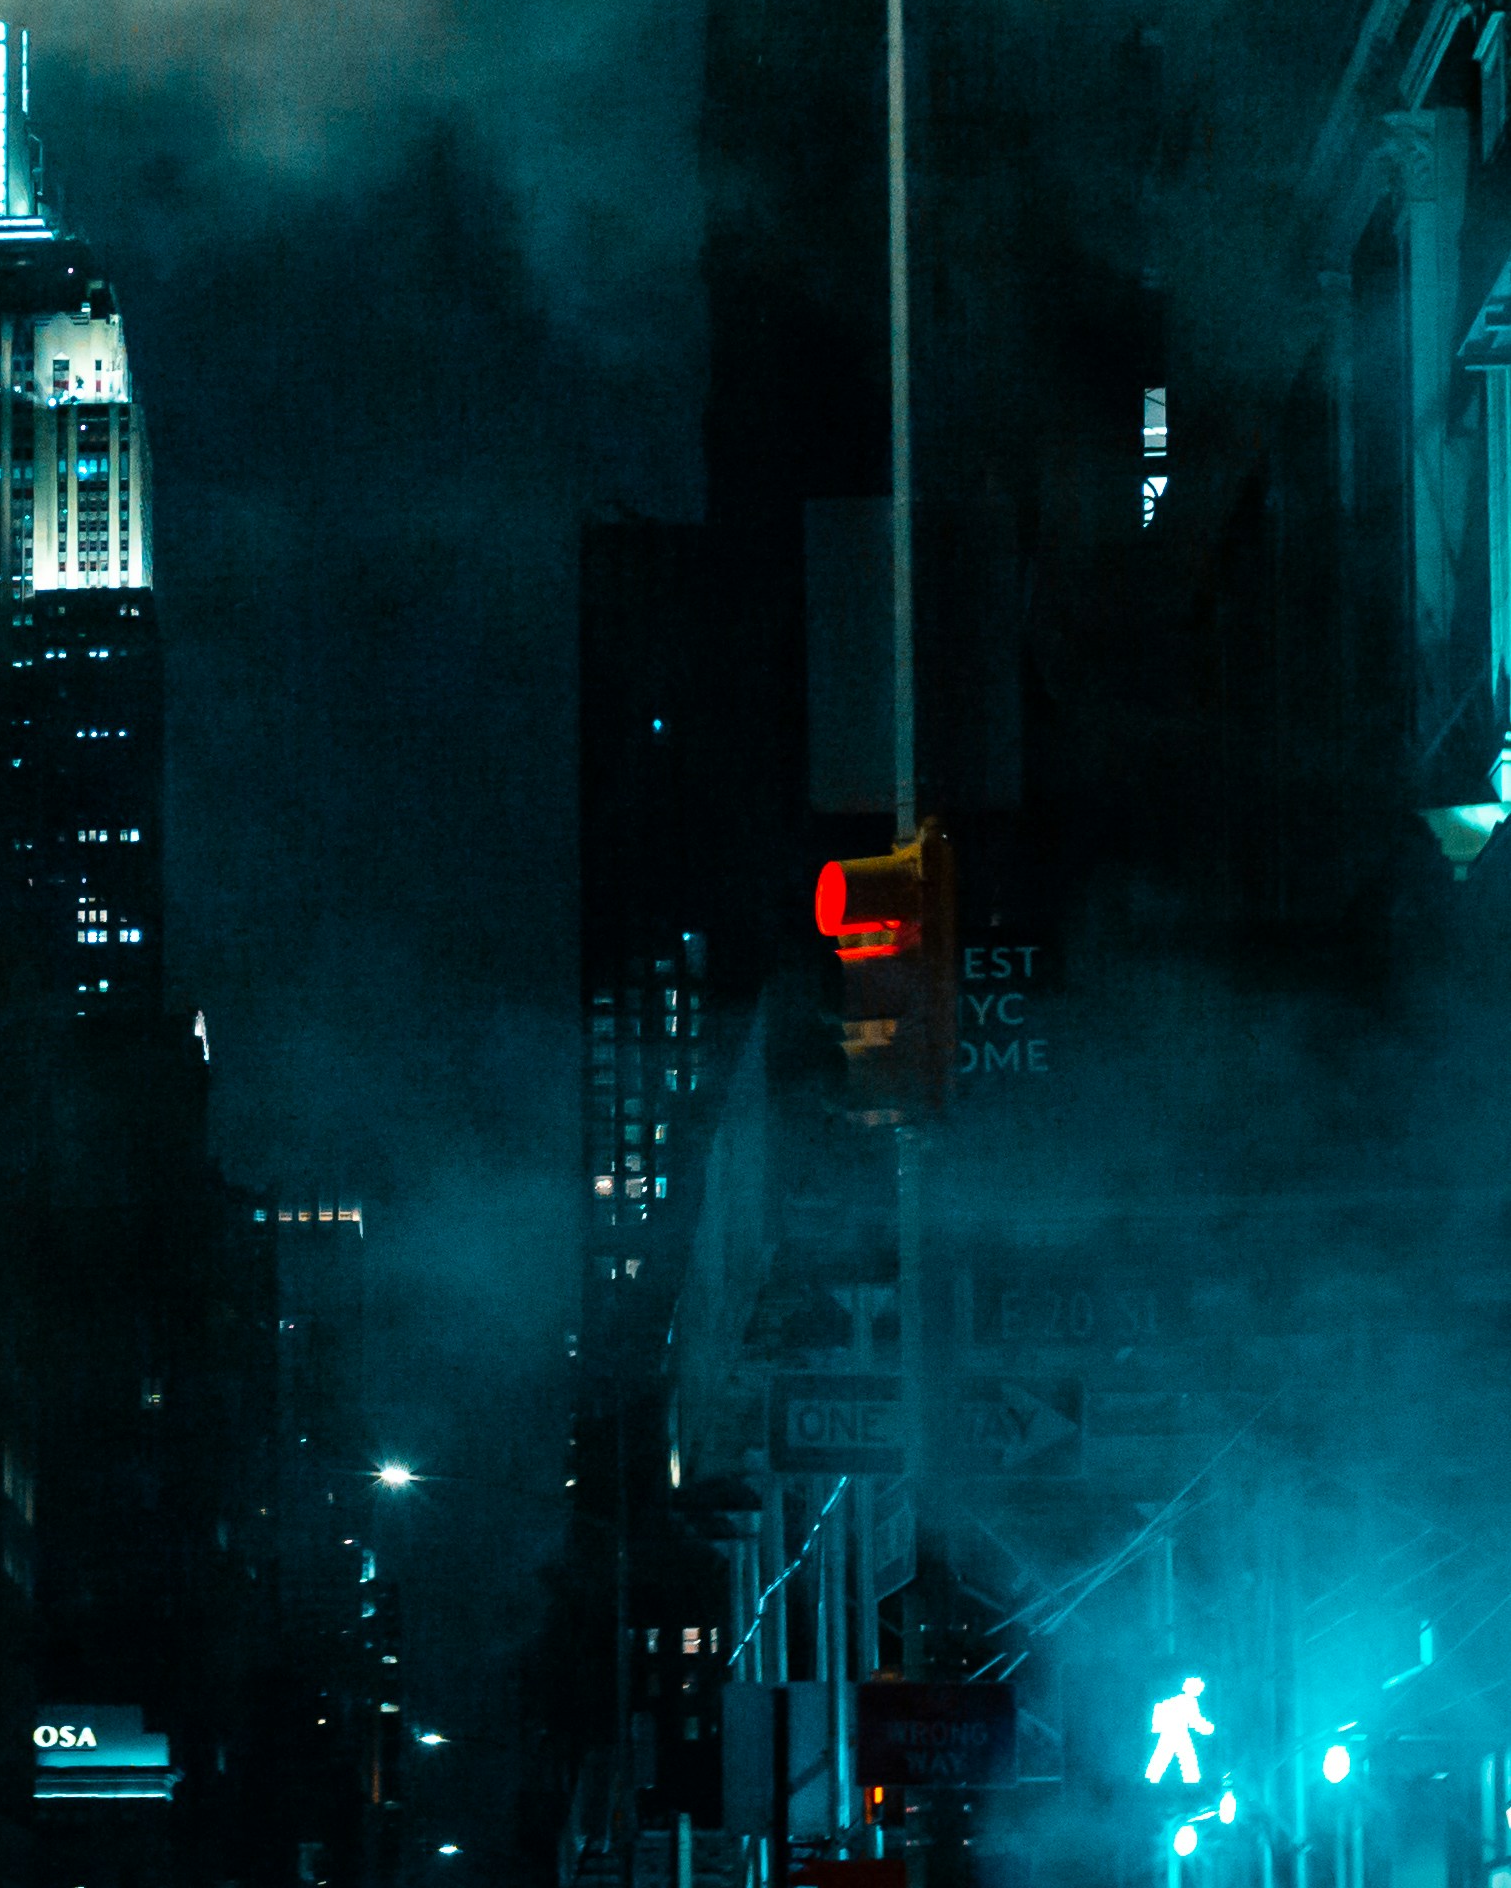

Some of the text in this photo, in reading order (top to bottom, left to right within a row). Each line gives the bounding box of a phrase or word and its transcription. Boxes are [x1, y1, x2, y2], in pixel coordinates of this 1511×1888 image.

[963, 945, 1041, 980] EST
[957, 992, 1025, 1026] YC
[959, 1038, 1050, 1074] OME
[799, 1406, 890, 1446] ONE
[33, 1725, 97, 1748] OSA
[886, 1720, 989, 1746] WRONG
[903, 1750, 968, 1775] WAY
